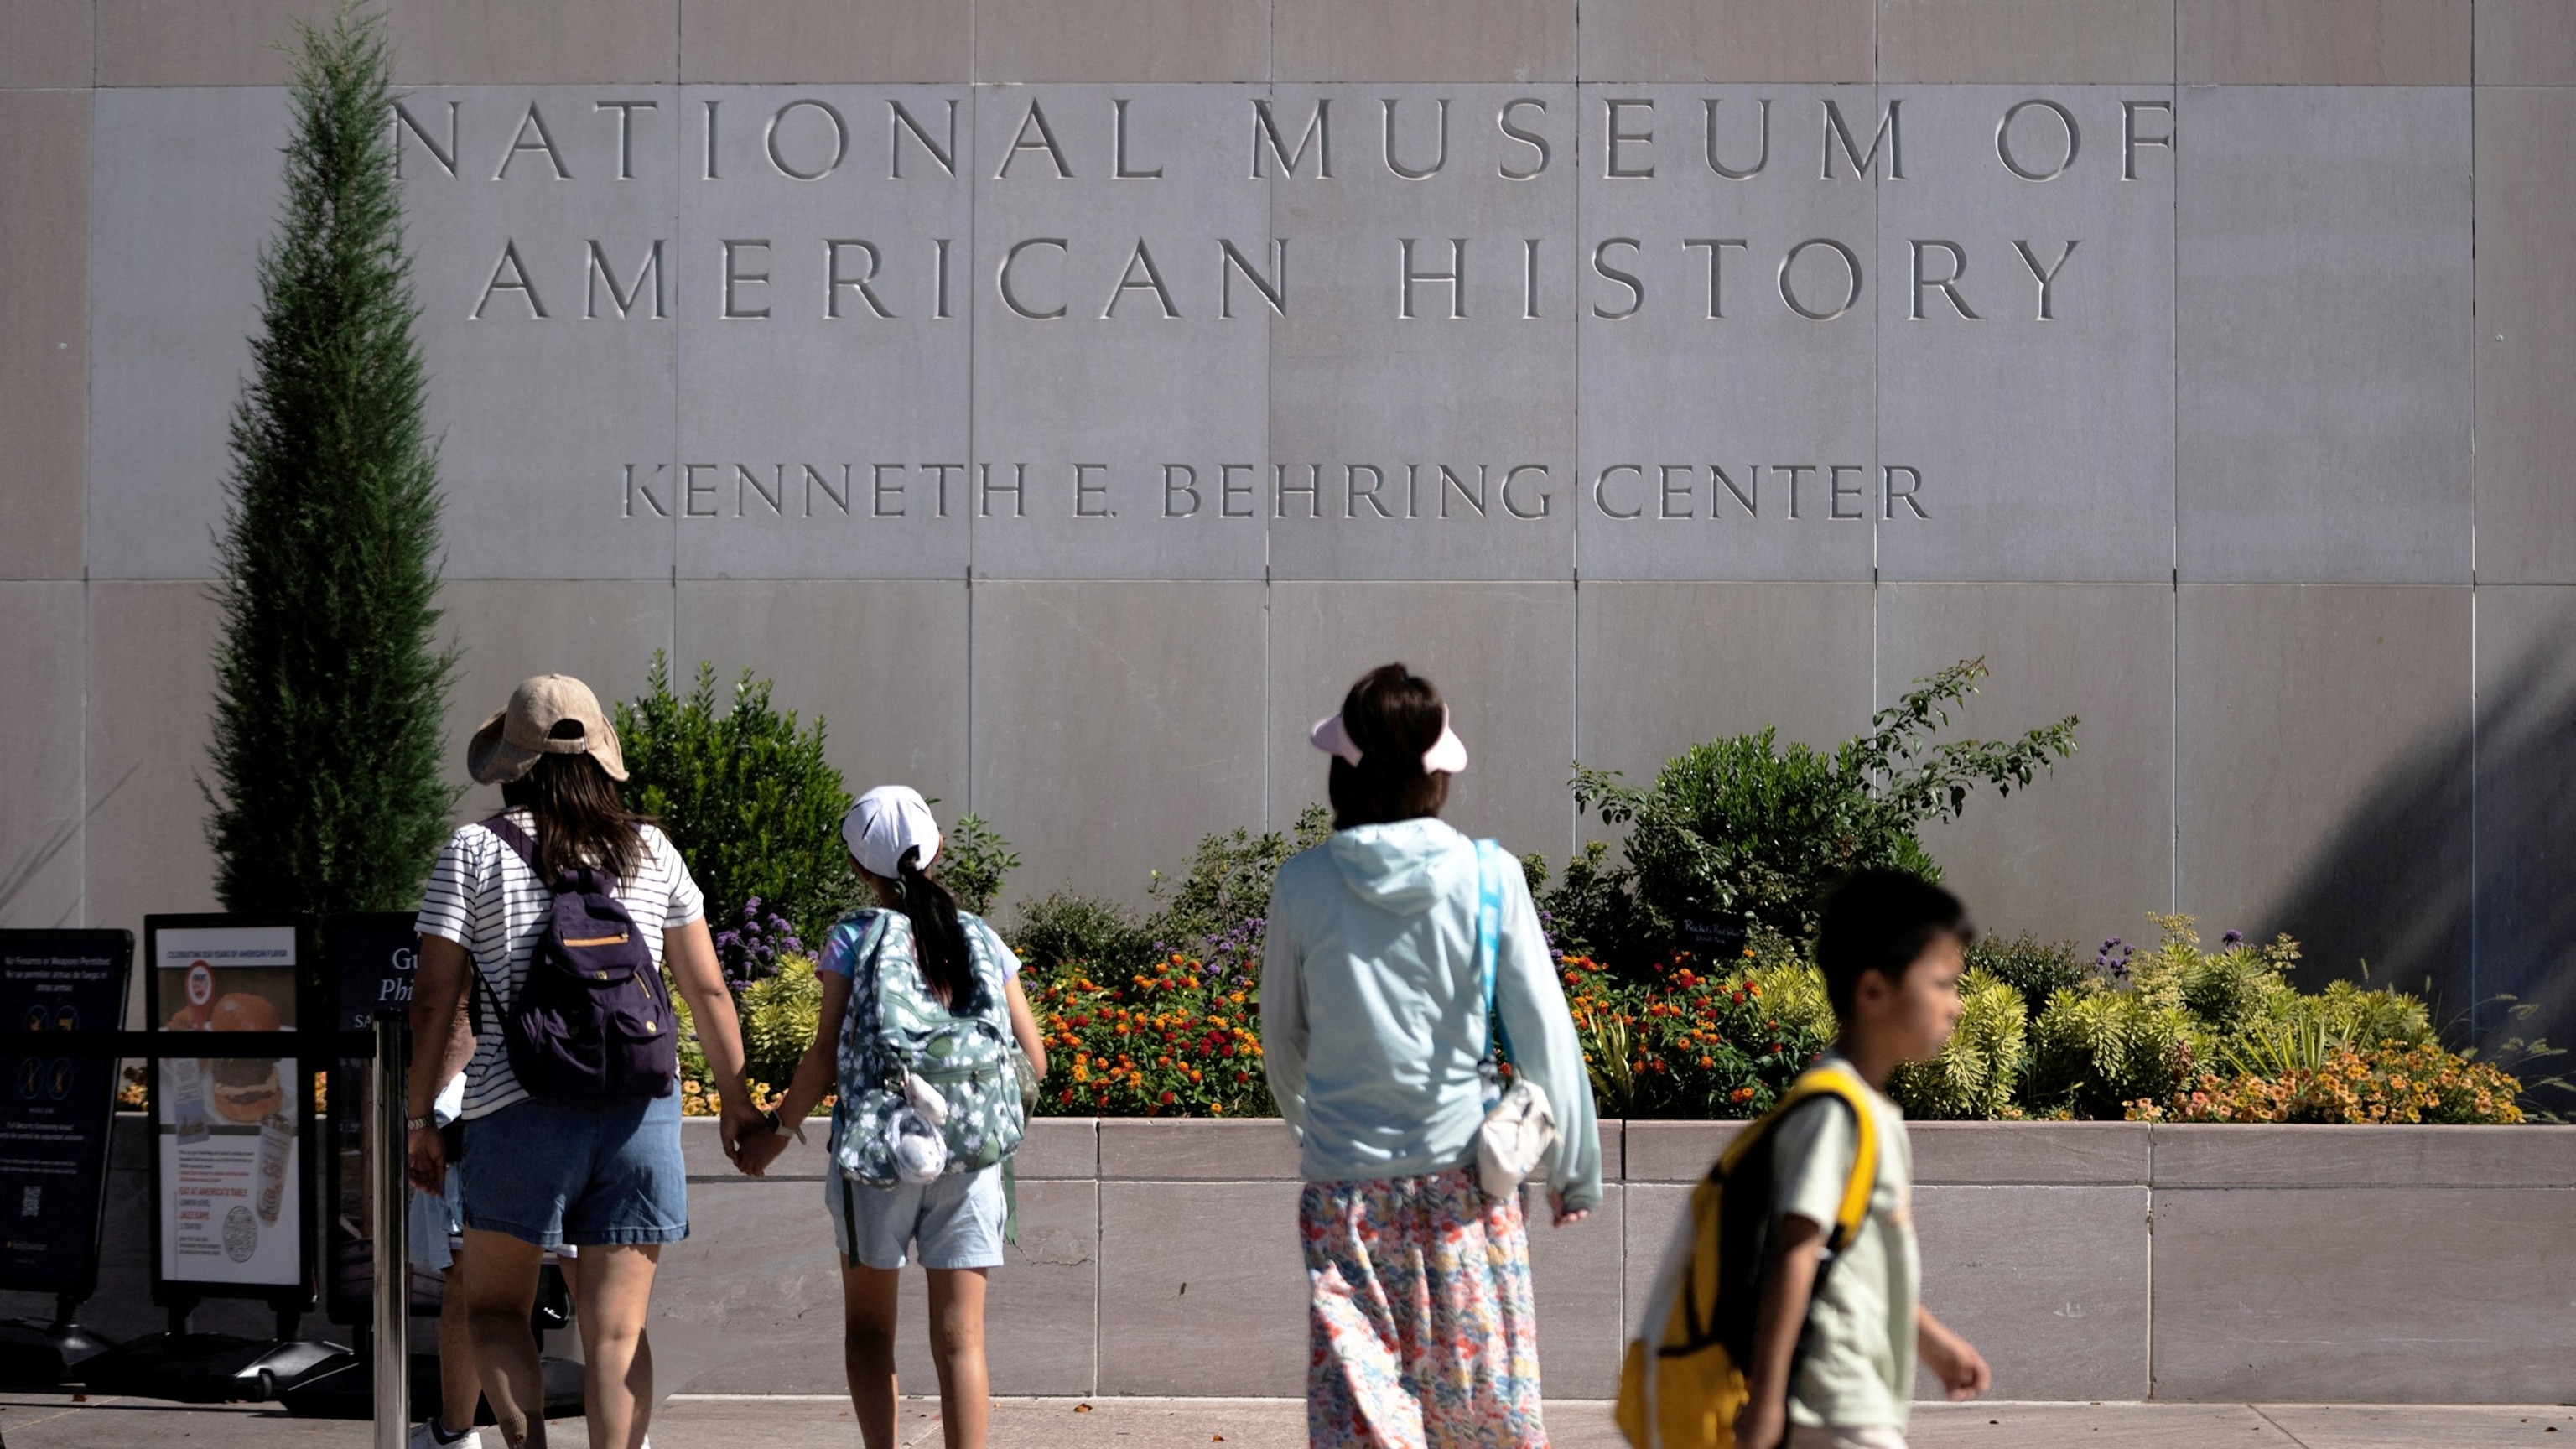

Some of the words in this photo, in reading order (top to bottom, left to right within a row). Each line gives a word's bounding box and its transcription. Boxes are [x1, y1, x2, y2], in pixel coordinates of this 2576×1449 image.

[389, 97, 1163, 181] NATIONAL
[1247, 97, 1907, 182] MUSEUM
[1994, 98, 2172, 183] OF
[467, 236, 1290, 321] AMERICAN
[1395, 237, 2082, 322] HISTORY
[621, 463, 1027, 518] KENNETH
[1070, 463, 1118, 518] E.
[1159, 463, 1551, 520] BEHRING
[1593, 464, 1932, 520] CENTER
